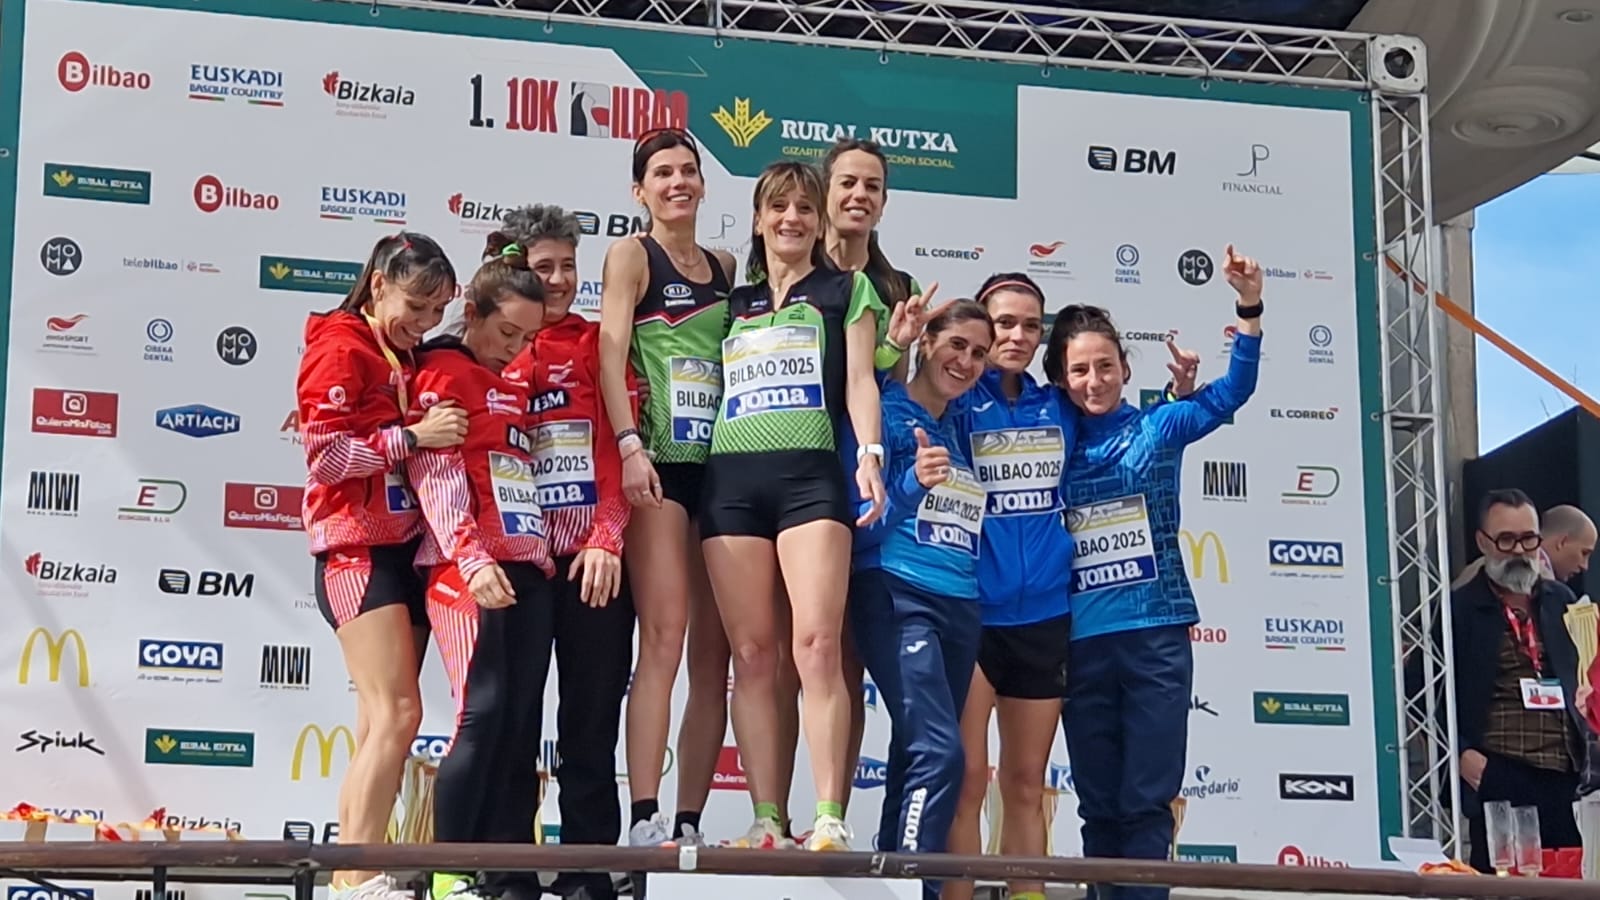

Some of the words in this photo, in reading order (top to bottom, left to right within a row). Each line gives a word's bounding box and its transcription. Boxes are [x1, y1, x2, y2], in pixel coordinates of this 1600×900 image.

[64, 60, 151, 90] Bilbao
[190, 64, 283, 87] EUSKADI
[189, 83, 229, 95] BASQUE
[231, 88, 283, 99] COUNTRY
[338, 80, 415, 105] Bizkaia
[469, 74, 494, 128] 1.
[506, 77, 559, 133] 10K
[781, 119, 863, 143] RURAL
[869, 127, 958, 153] KUTXA
[918, 156, 954, 168] SOCIAL
[1123, 148, 1176, 175] BM
[201, 183, 279, 210] Bilbao
[321, 186, 406, 207] EUSKADI
[1222, 182, 1283, 195] FINANCIAL
[320, 204, 357, 214] BASQUE
[123, 257, 178, 270] telebilbao
[915, 247, 929, 257] EL
[931, 248, 980, 260] CORREO
[1265, 267, 1297, 278] bilbao
[730, 360, 777, 387] BILBAO
[780, 357, 815, 376] 2025
[160, 412, 237, 431] ARTIACH
[1270, 408, 1284, 418] EL
[1286, 409, 1335, 420] CORREO
[557, 455, 588, 472] 2025
[979, 462, 1033, 482] BILBAO
[1035, 460, 1061, 478] 2025
[1203, 461, 1247, 497] MIWI
[28, 471, 80, 511] MIWI
[1073, 536, 1109, 559] LBAO
[1111, 530, 1146, 551] 2025
[1273, 543, 1340, 564] GOYA
[40, 561, 117, 584] Bizkaia
[197, 572, 254, 598] BM
[1265, 618, 1343, 634] EUSKADI
[143, 643, 219, 666] GOYA
[260, 645, 310, 685] MIWI
[1182, 778, 1239, 799] omedario
